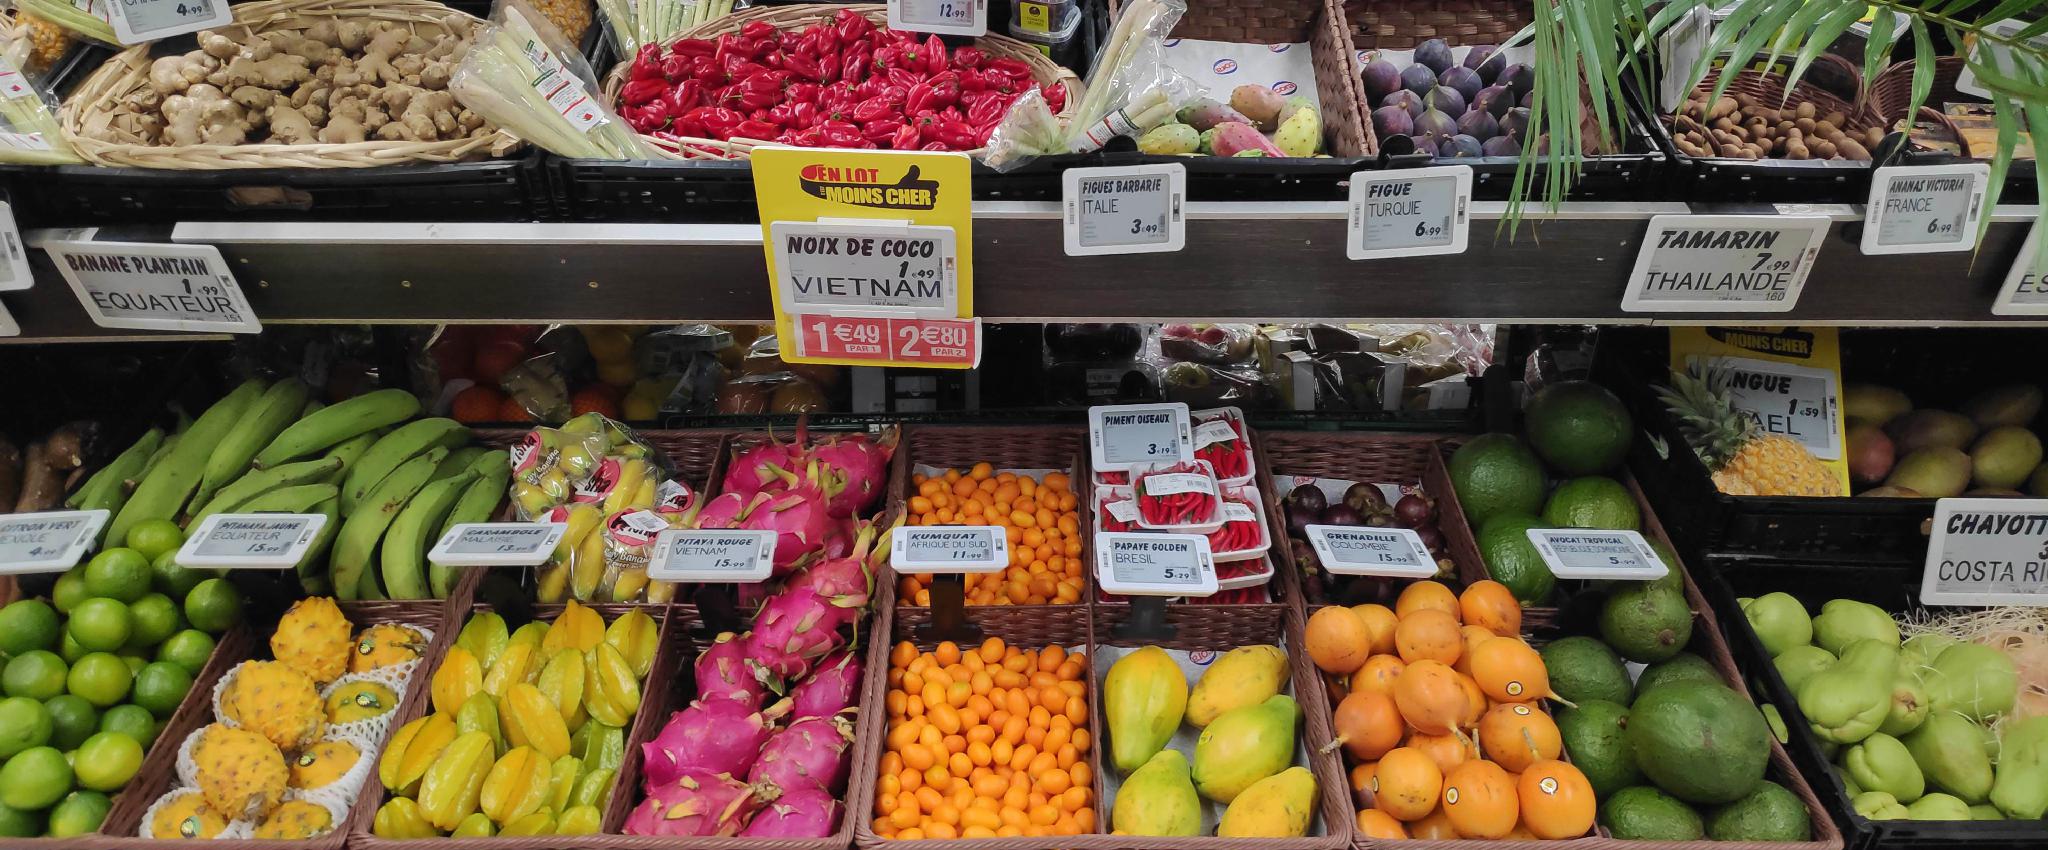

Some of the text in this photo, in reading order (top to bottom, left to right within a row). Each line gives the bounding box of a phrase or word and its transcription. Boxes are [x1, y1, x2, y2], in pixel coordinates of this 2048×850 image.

[817, 167, 879, 182] EN LOT
[1082, 179, 1161, 194] FIGUES BARBARIE
[1368, 183, 1412, 198] FIGUE
[1889, 178, 1965, 194] ANANAS VICTORIA
[826, 187, 932, 206] MOINS CHER
[1082, 199, 1119, 214] ITALIE
[1368, 200, 1422, 217] TURQUIE
[1885, 198, 1933, 213] FRANCE
[1657, 230, 1780, 249] TAMARIN
[787, 237, 934, 258] NOIX DE COCO
[64, 254, 209, 276] BANANE PLANTAIN
[792, 276, 941, 299] VIETNAM
[1646, 272, 1791, 291] THAILANDE
[89, 291, 237, 314] EQUATEUR
[849, 345, 868, 353] PAR
[1725, 332, 1808, 353] MOINS CHER
[935, 348, 954, 356] PAR
[1105, 414, 1170, 427] PIMENT OISEAUX
[49, 521, 82, 530] VERT
[267, 522, 301, 530] JAUNE
[211, 531, 281, 540] EQUATEUR
[677, 538, 753, 546] PITAYA ROUGE
[910, 533, 975, 541] KUMQUAT
[1327, 533, 1397, 543] GRENADILLE
[1582, 537, 1624, 545] TROPICAL
[674, 547, 727, 556] VIETNAM
[908, 541, 947, 549] AFRIQUE
[966, 540, 987, 549] SUD
[1114, 542, 1188, 552] PAPAYE GOLDEN
[1331, 540, 1392, 551] COLOMBIE
[1115, 553, 1157, 565] BRESIL
[1938, 560, 2014, 582] COSTA
